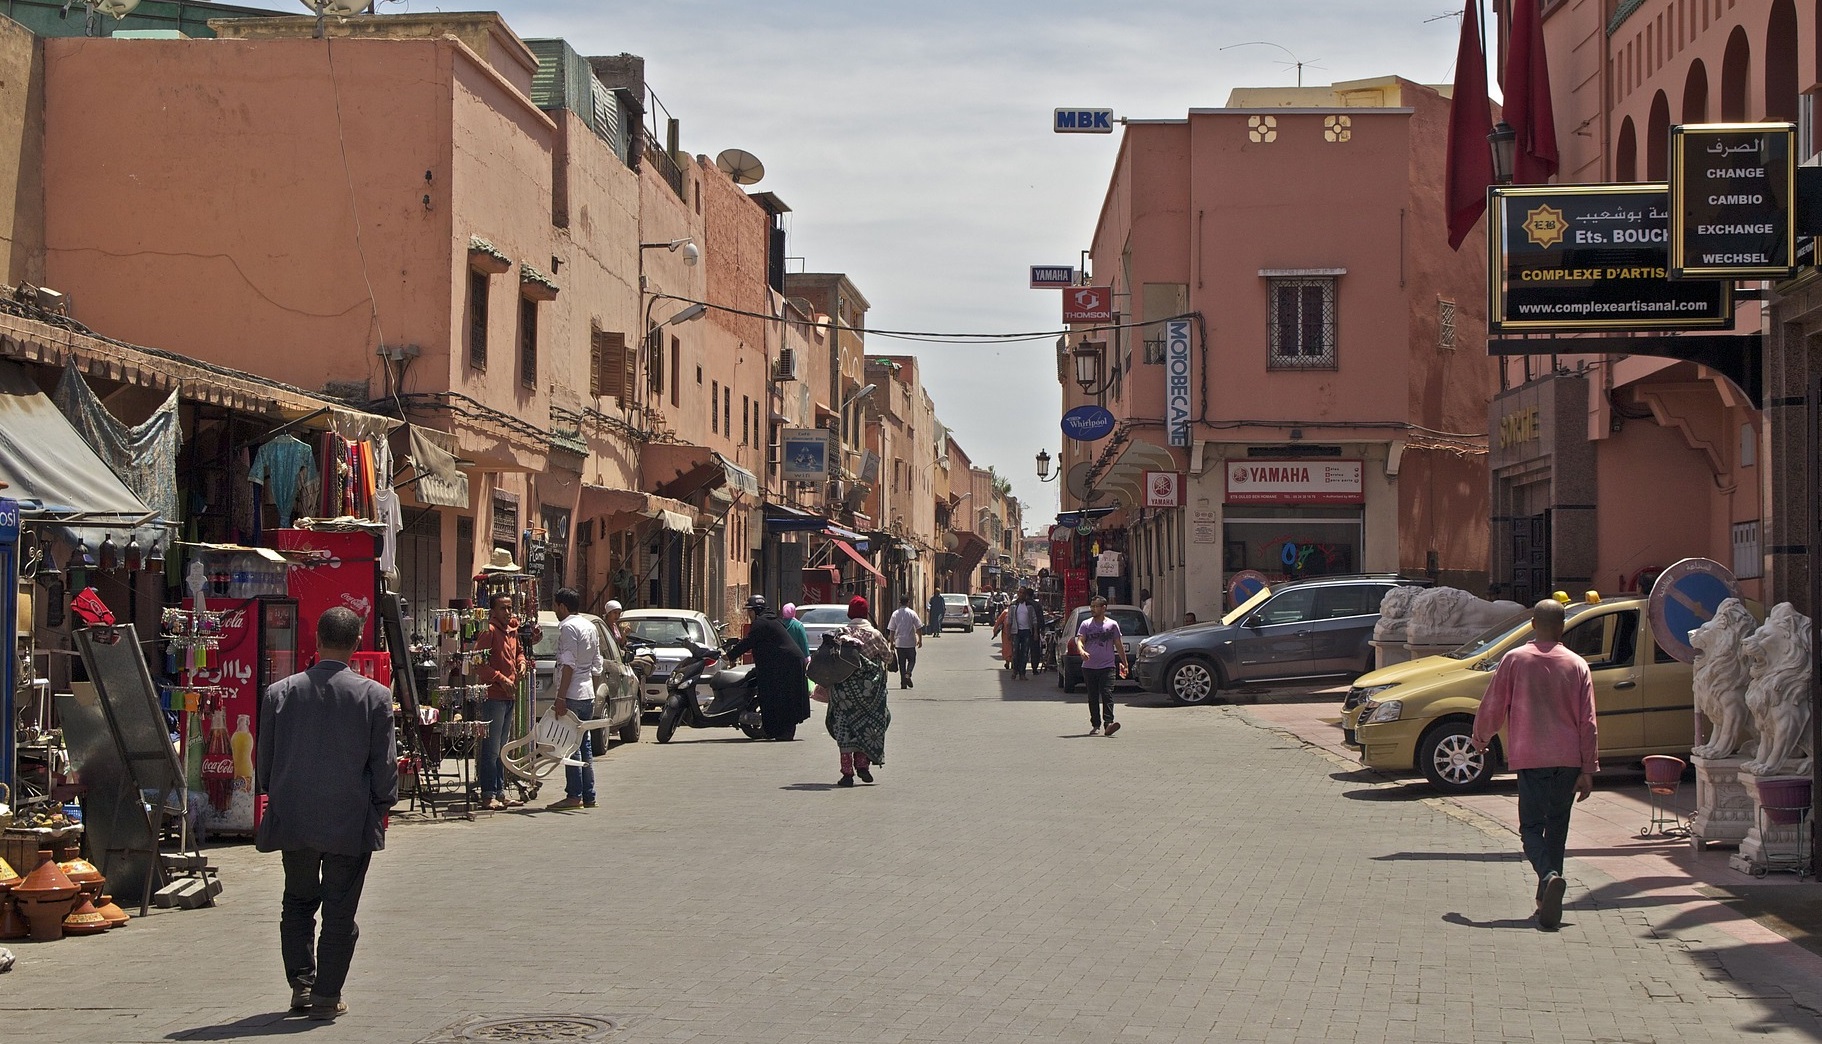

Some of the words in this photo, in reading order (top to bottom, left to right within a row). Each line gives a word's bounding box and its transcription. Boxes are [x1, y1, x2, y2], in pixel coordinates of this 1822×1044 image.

[1057, 111, 1111, 128] MBK
[1706, 138, 1765, 158] الصرف
[1706, 168, 1765, 178] CHANGE
[1708, 194, 1763, 205] CAMBIO
[1576, 206, 1642, 224] بوشعيب
[1697, 224, 1773, 235] EXCHANGE
[1576, 230, 1608, 244] Ets.
[1702, 253, 1769, 264] WECHSEL
[1035, 269, 1068, 281] YAMAHA
[1521, 268, 1602, 281] COMPLEXE
[1606, 267, 1668, 279] D'ARTIS
[1518, 300, 1708, 315] www.complexeartisanal.com
[1064, 311, 1110, 319] THOMSON
[1170, 322, 1188, 445] MOTOBECANE
[1070, 416, 1108, 428] Whirlpool
[1250, 467, 1310, 483] YAMAHA
[1151, 498, 1174, 506] YAMAHA
